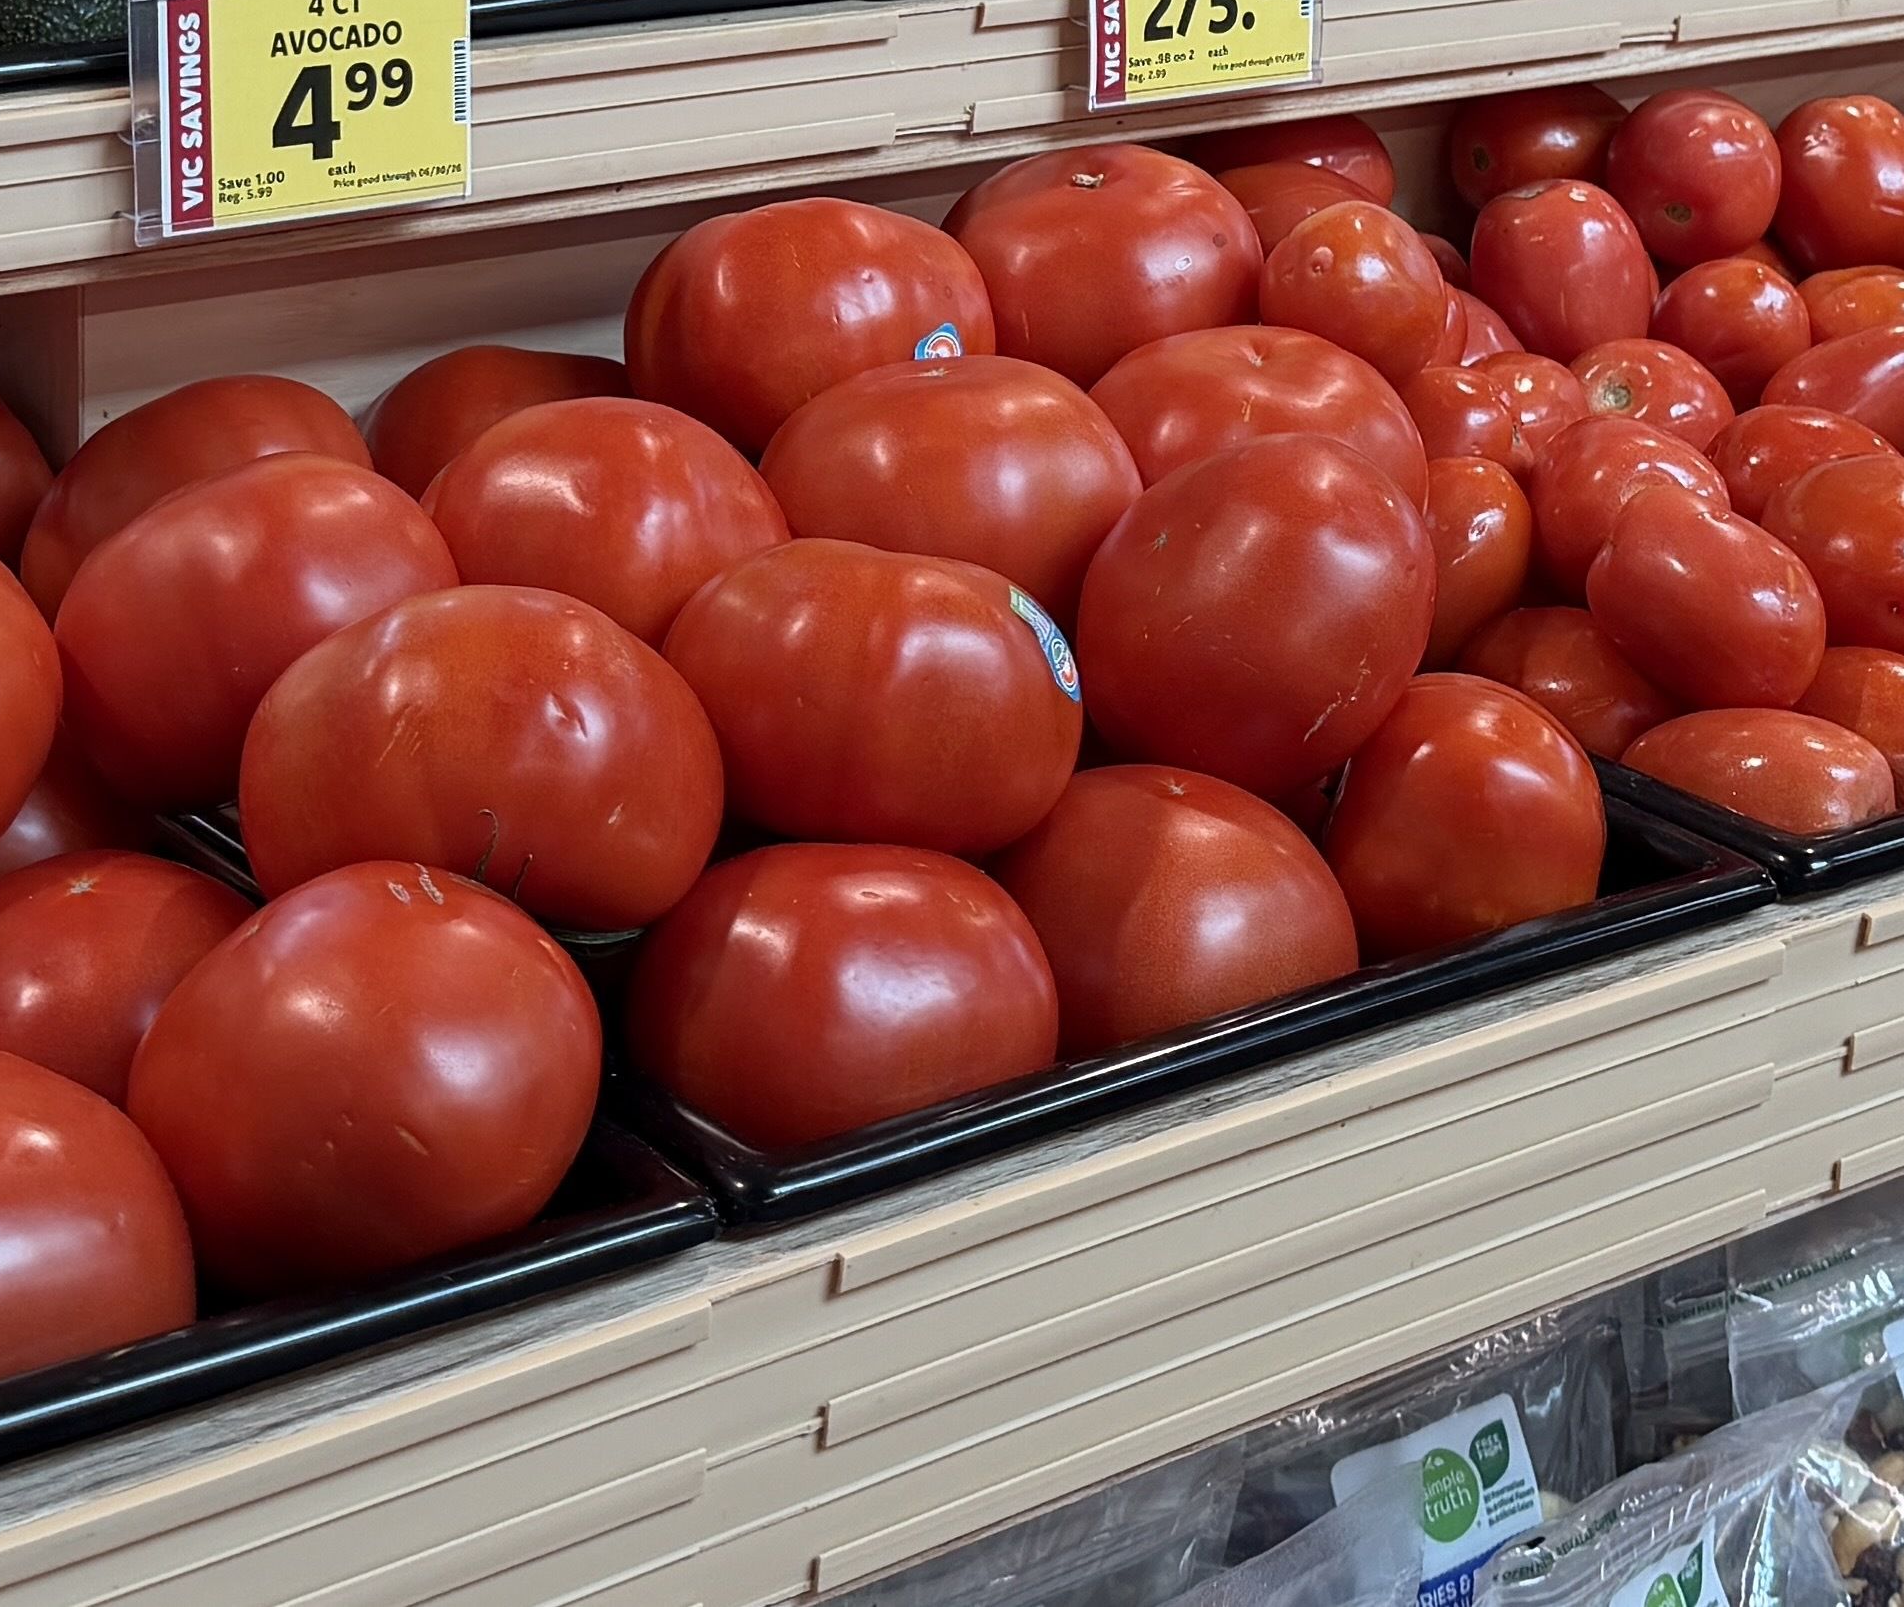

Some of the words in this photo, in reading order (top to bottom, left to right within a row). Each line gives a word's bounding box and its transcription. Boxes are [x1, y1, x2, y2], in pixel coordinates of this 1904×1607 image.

[270, 20, 403, 58] AVOCADO
[1207, 45, 1229, 58] each
[1103, 41, 1121, 89] VIC
[1128, 56, 1152, 69] Save
[1230, 59, 1247, 71] good
[1247, 56, 1275, 69] through
[179, 11, 204, 149] SAVINGS
[1128, 72, 1146, 85] Reg.
[327, 161, 356, 177] each
[333, 178, 355, 189] Price
[357, 174, 381, 188] good
[382, 168, 418, 183] through
[181, 155, 204, 212] VIC
[217, 177, 252, 191] Save
[255, 170, 286, 186] 1.00
[218, 192, 244, 204] Reg.
[246, 186, 273, 200] 5.99
[1424, 1485, 1474, 1524] truth
